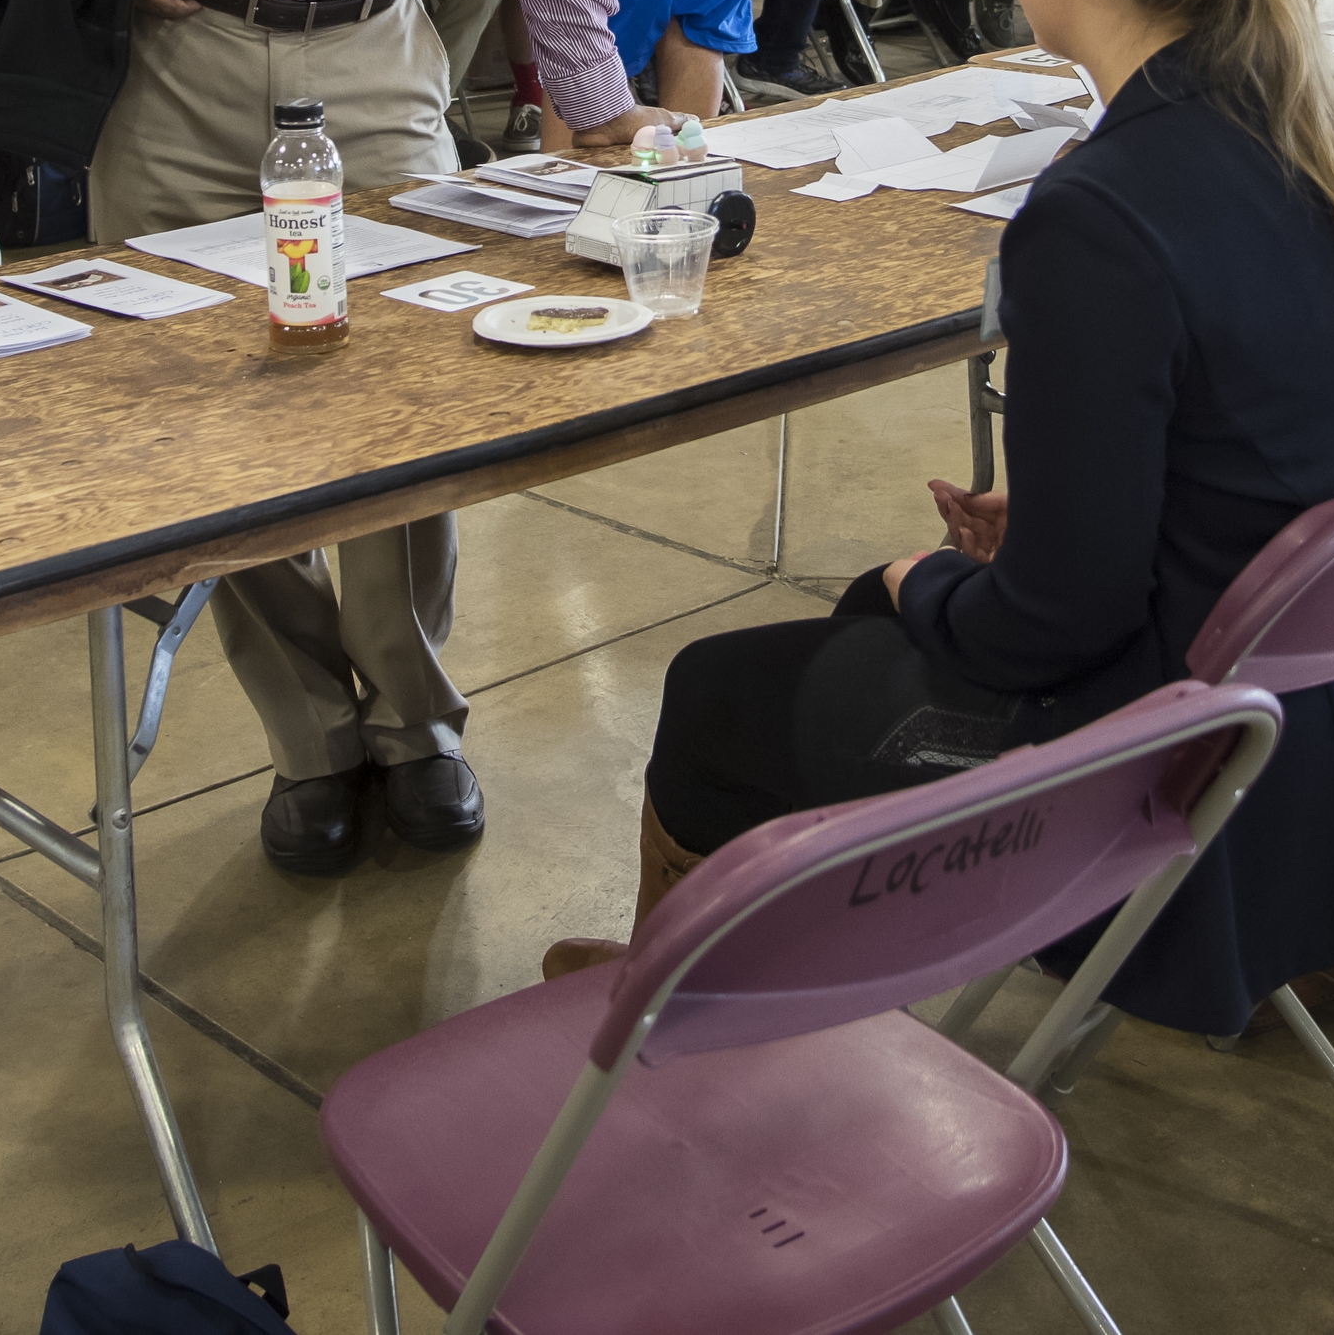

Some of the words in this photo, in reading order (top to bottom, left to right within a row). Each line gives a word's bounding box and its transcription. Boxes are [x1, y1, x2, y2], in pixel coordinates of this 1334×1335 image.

[268, 213, 327, 229] Honest
[289, 229, 303, 237] tea
[418, 280, 510, 305] 30
[283, 301, 302, 309] Peach
[304, 301, 317, 309] Tea
